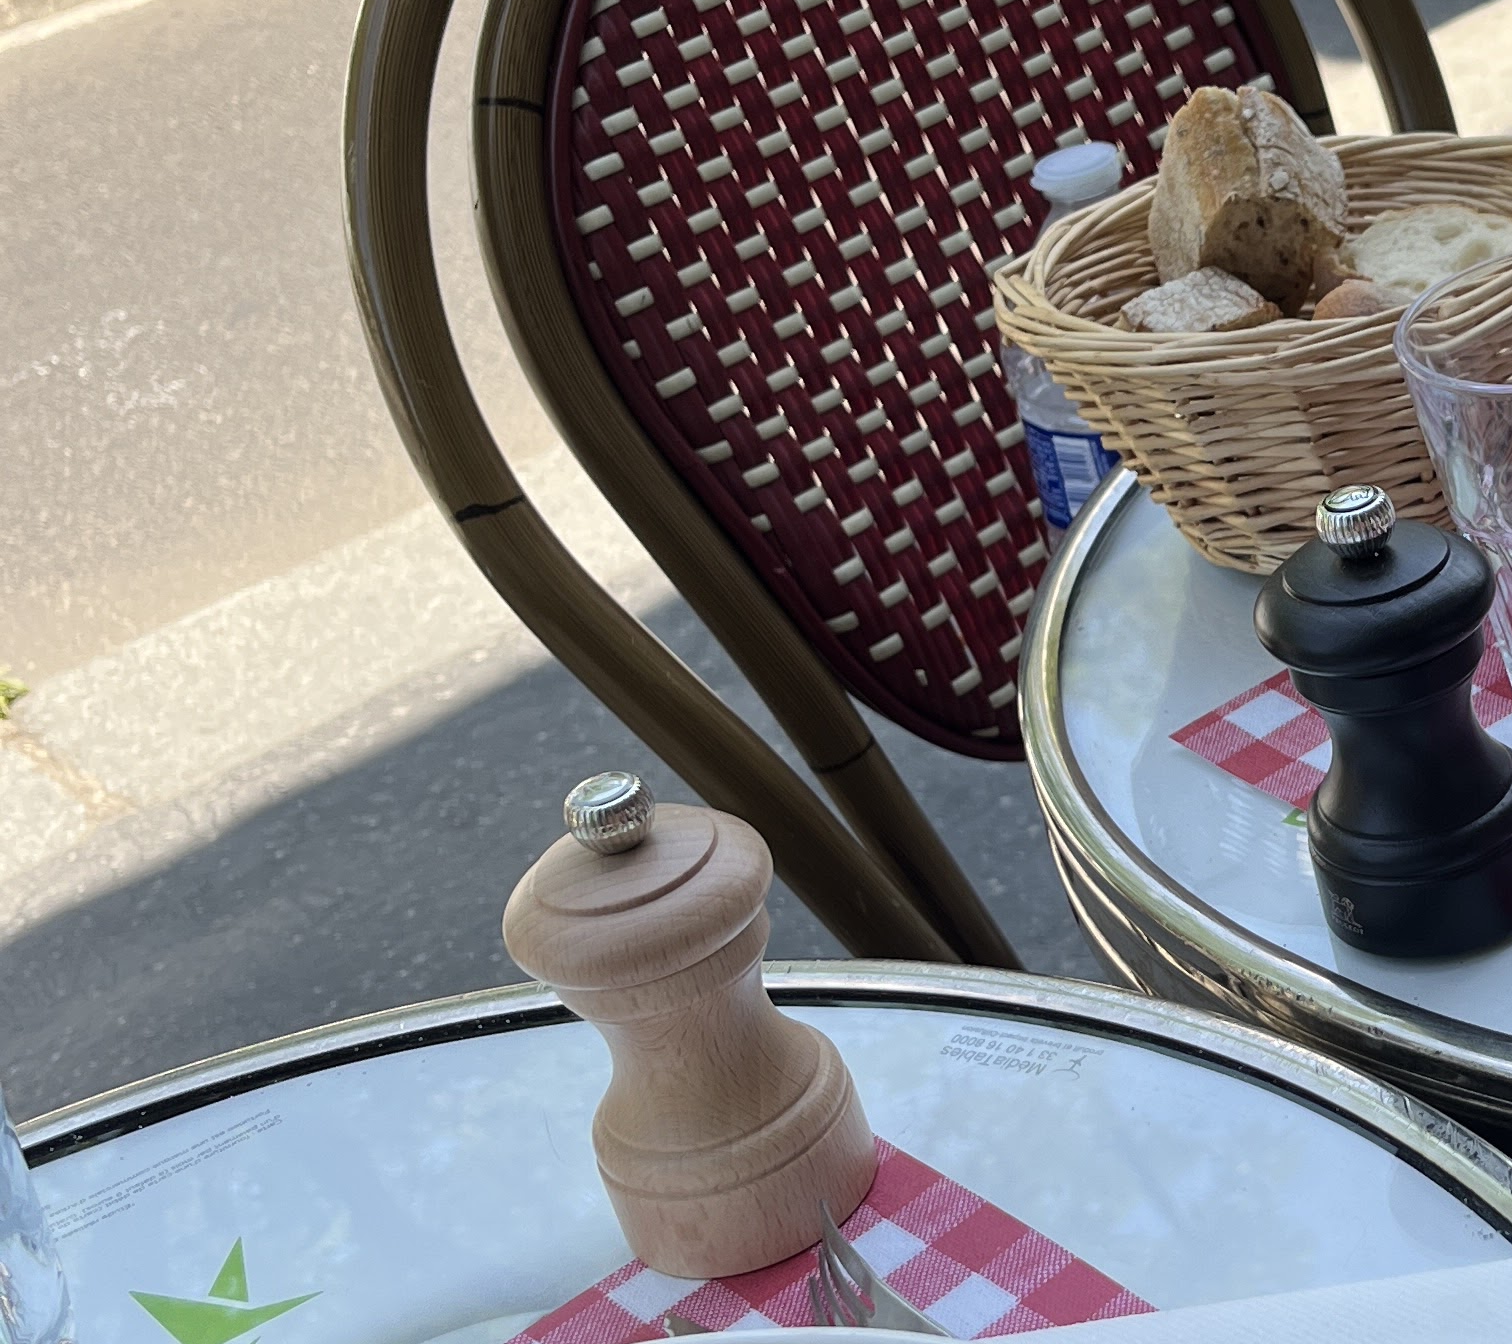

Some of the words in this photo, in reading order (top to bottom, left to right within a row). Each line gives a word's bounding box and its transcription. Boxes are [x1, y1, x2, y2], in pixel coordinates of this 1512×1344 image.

[951, 1034, 985, 1048] 8000
[986, 1040, 1003, 1052] 16
[1006, 1044, 1025, 1055] 40
[1027, 1048, 1036, 1057] 1
[940, 1045, 1047, 1076] MédiaTables
[1038, 1051, 1058, 1061] 33
